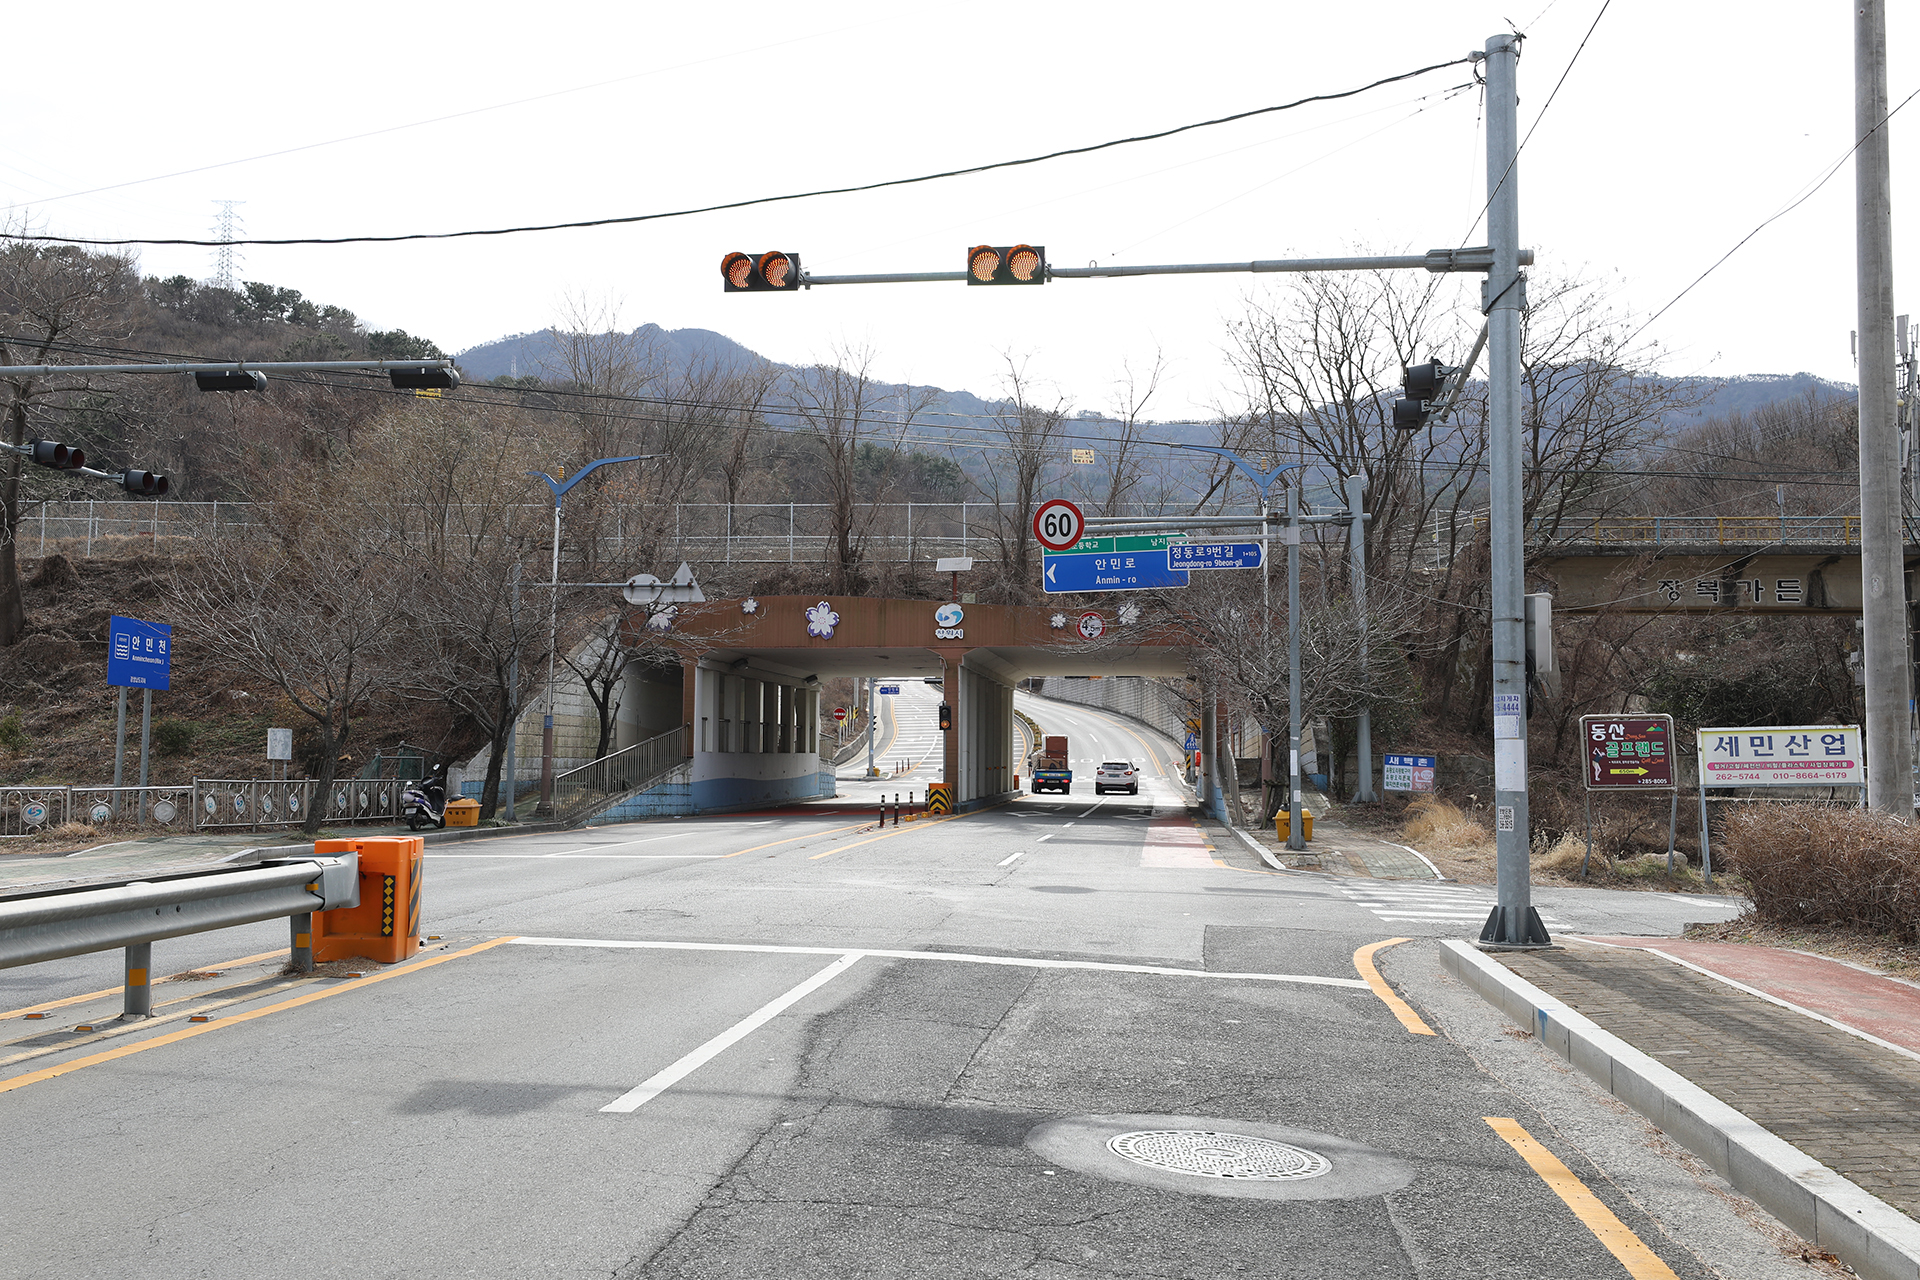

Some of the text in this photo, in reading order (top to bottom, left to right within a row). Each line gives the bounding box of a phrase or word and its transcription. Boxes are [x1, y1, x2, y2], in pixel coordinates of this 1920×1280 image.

[1044, 513, 1071, 537] 60
[1172, 546, 1234, 559] 정동로9번길
[1095, 558, 1136, 570] 안민로
[1172, 558, 1243, 568] Jeongdong-ro 9beon-gil
[936, 628, 964, 638] 창원시
[132, 636, 166, 654] 안민천
[1591, 724, 1625, 741] 동산
[1605, 741, 1665, 758] 골프랜드
[1714, 734, 1846, 757] 세민산업
